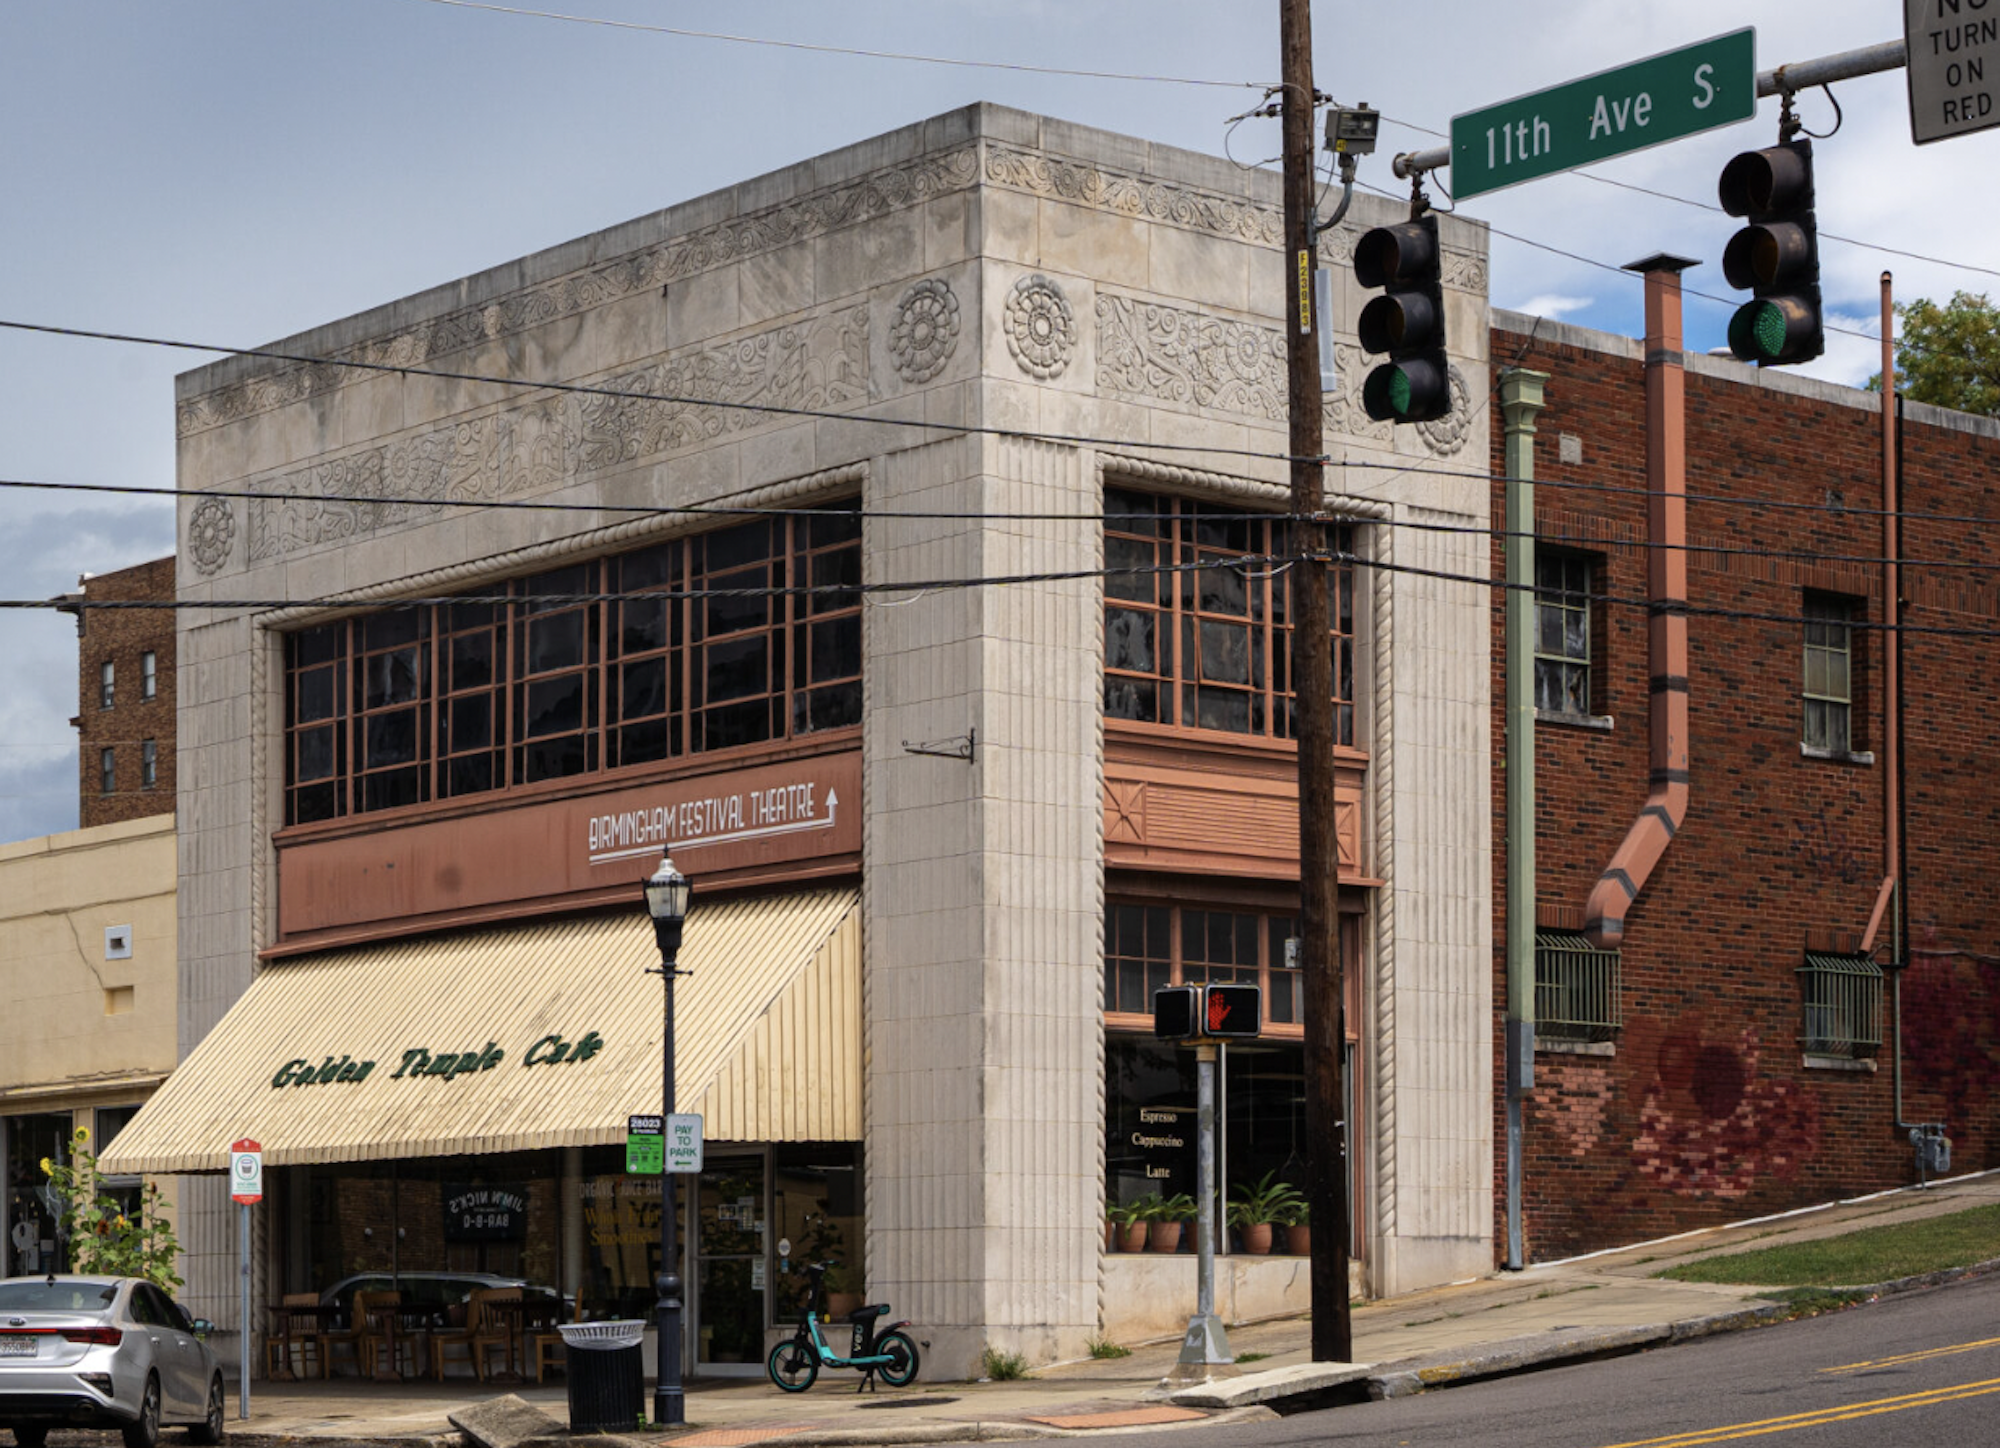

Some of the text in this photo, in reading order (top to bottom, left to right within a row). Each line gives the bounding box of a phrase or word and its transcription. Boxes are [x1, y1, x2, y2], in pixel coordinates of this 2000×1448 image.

[1929, 18, 1997, 55] TURN
[1947, 57, 1983, 87] ON
[1486, 63, 1714, 170] 11th Ave S
[1944, 92, 1991, 124] RED
[589, 782, 815, 850] BIRMINGHAM FESTIVAL THEATRE
[270, 1030, 605, 1090] Golden Temple Cafe
[1140, 1109, 1178, 1124] Espresso
[675, 1124, 693, 1135] PAY
[677, 1136, 691, 1145] TO
[1131, 1132, 1184, 1148] Cappuccino
[670, 1147, 697, 1157] PARK
[1146, 1164, 1171, 1178] Latte
